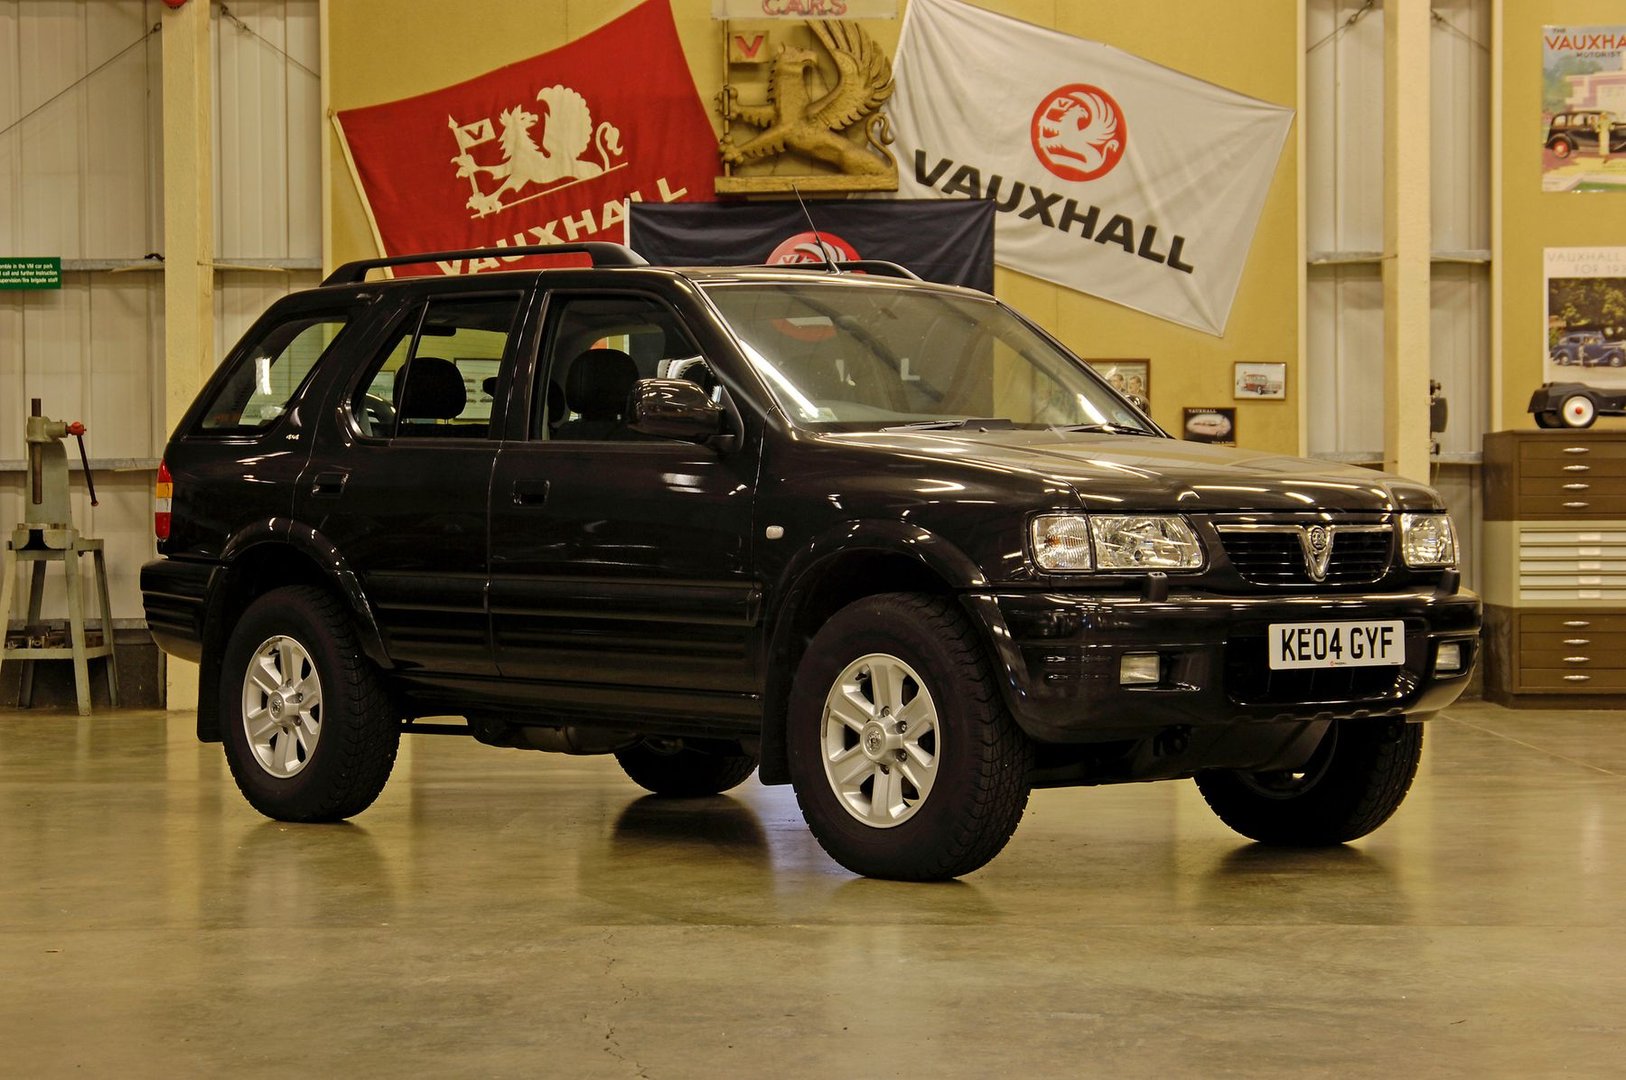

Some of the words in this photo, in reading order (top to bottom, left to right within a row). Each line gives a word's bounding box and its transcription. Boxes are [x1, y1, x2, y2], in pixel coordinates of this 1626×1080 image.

[762, 0, 848, 16] CARS
[734, 35, 765, 59] V
[1544, 33, 1626, 50] VAUXHA
[1577, 50, 1622, 58] MOTORIST
[464, 124, 484, 141] V
[915, 149, 1194, 274] VAUXHALL
[1547, 252, 1621, 263] VAUXHALL
[1281, 627, 1343, 661] KE04
[1349, 626, 1394, 660] GYF
